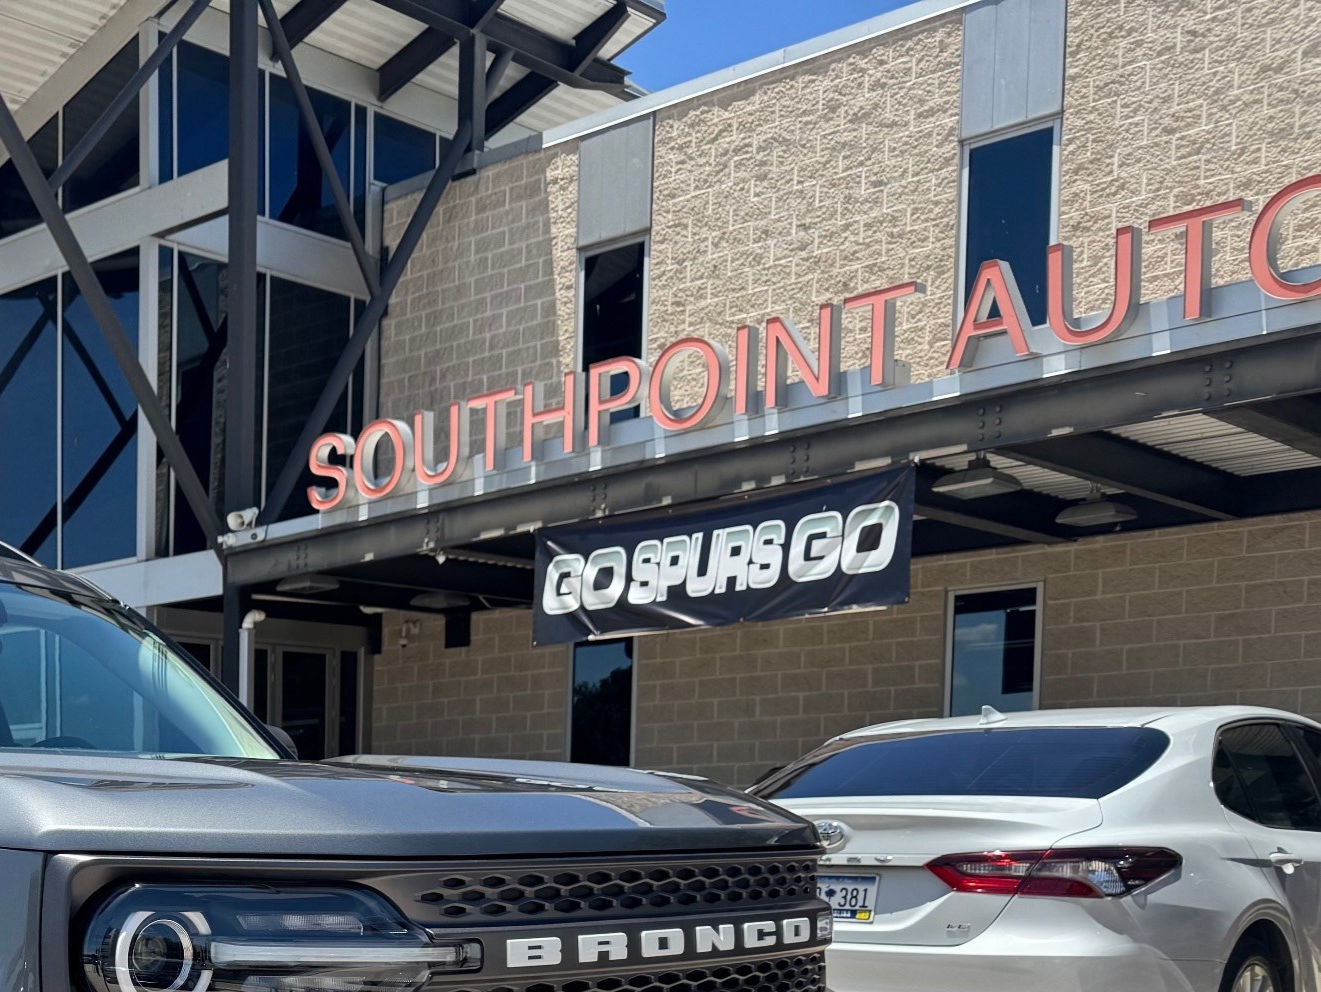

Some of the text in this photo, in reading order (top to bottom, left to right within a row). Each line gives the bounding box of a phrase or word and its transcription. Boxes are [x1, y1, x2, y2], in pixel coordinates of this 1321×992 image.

[308, 283, 923, 511] SOUTHPOINT
[541, 500, 900, 615] GO SPURS GO
[838, 887, 869, 909] 381
[506, 917, 811, 968] BRONCO
